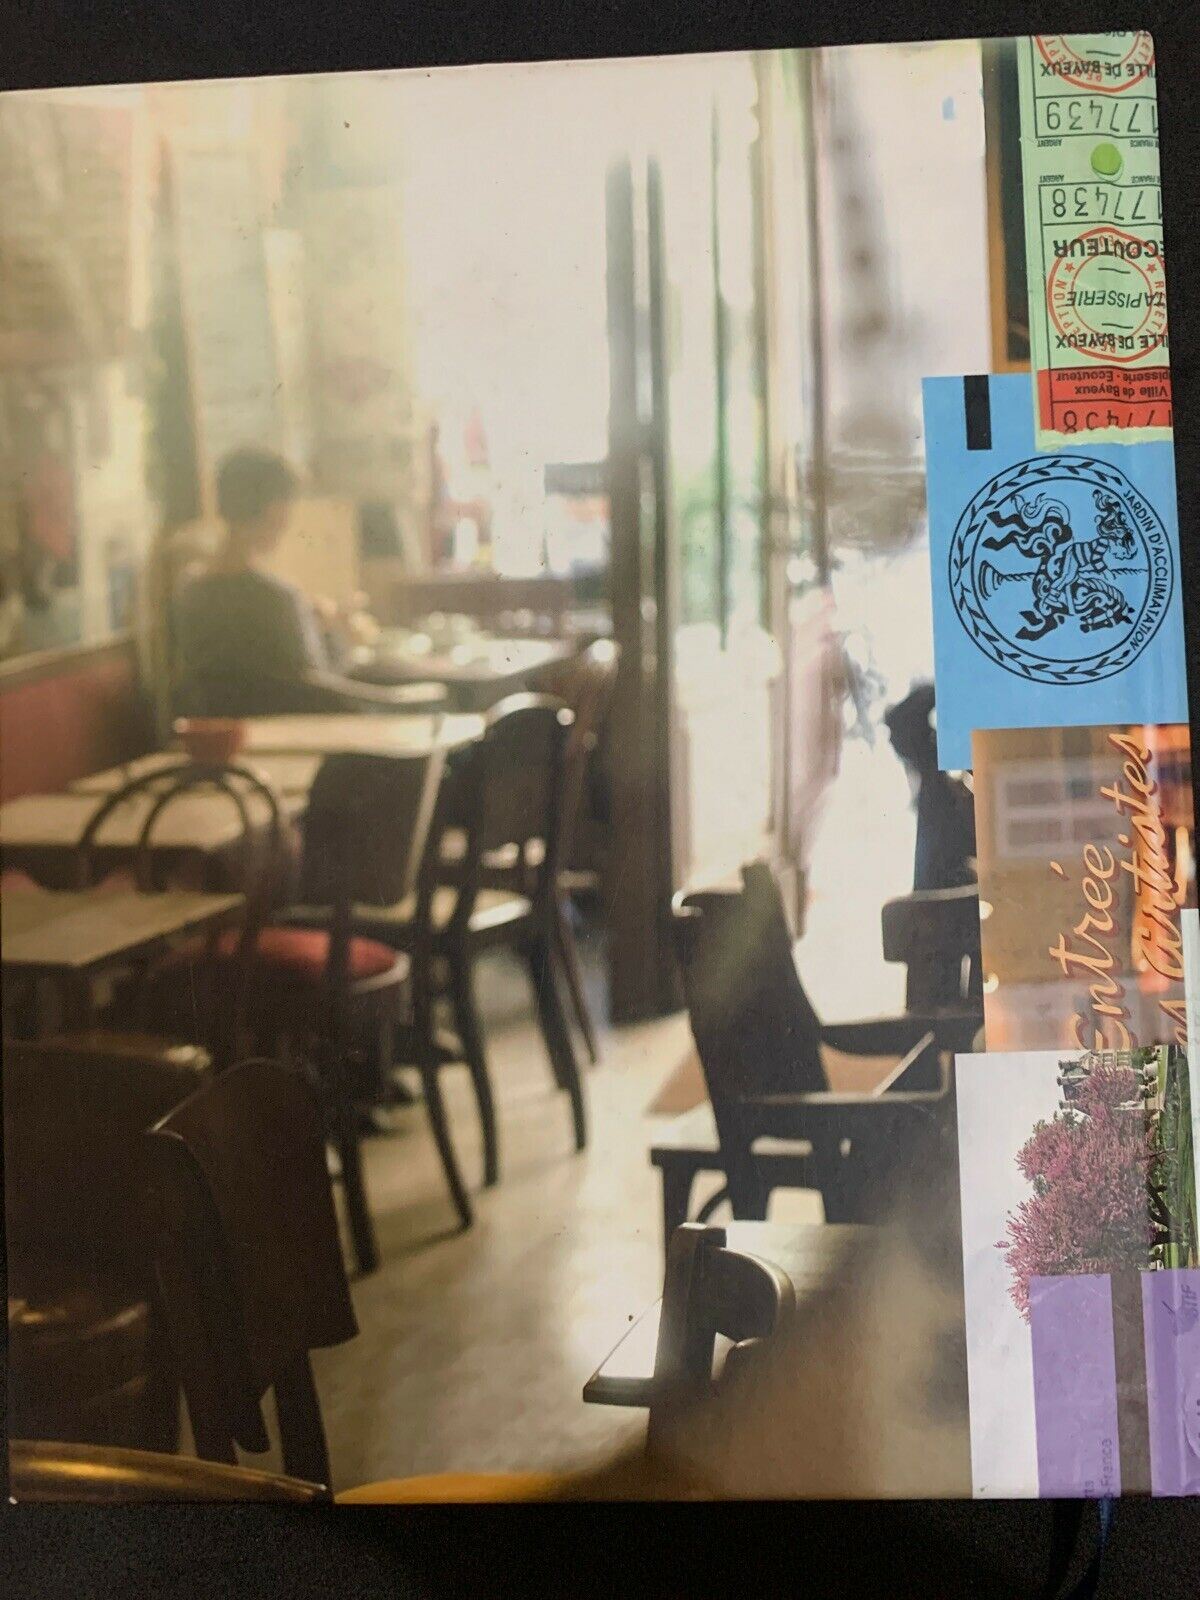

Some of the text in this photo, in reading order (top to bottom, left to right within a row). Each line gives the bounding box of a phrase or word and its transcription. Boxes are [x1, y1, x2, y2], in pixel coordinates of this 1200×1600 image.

[1041, 61, 1101, 77] BAYEUX
[1105, 63, 1121, 78] DE
[1046, 100, 1159, 133] 177439
[1037, 139, 1062, 147] ARGENT
[1040, 174, 1064, 183] ARGENT
[1052, 186, 1162, 220] 177438
[1066, 290, 1166, 308] TAPISSERIE
[1056, 333, 1118, 349] BAYEUX
[1119, 335, 1134, 349] DE
[1057, 370, 1113, 382] Ecouteur
[1075, 385, 1168, 397] Ville de Bayeux
[1123, 490, 1168, 651] JARDIN D'ACCLIMATATION
[1049, 844, 1130, 1050] Entrée
